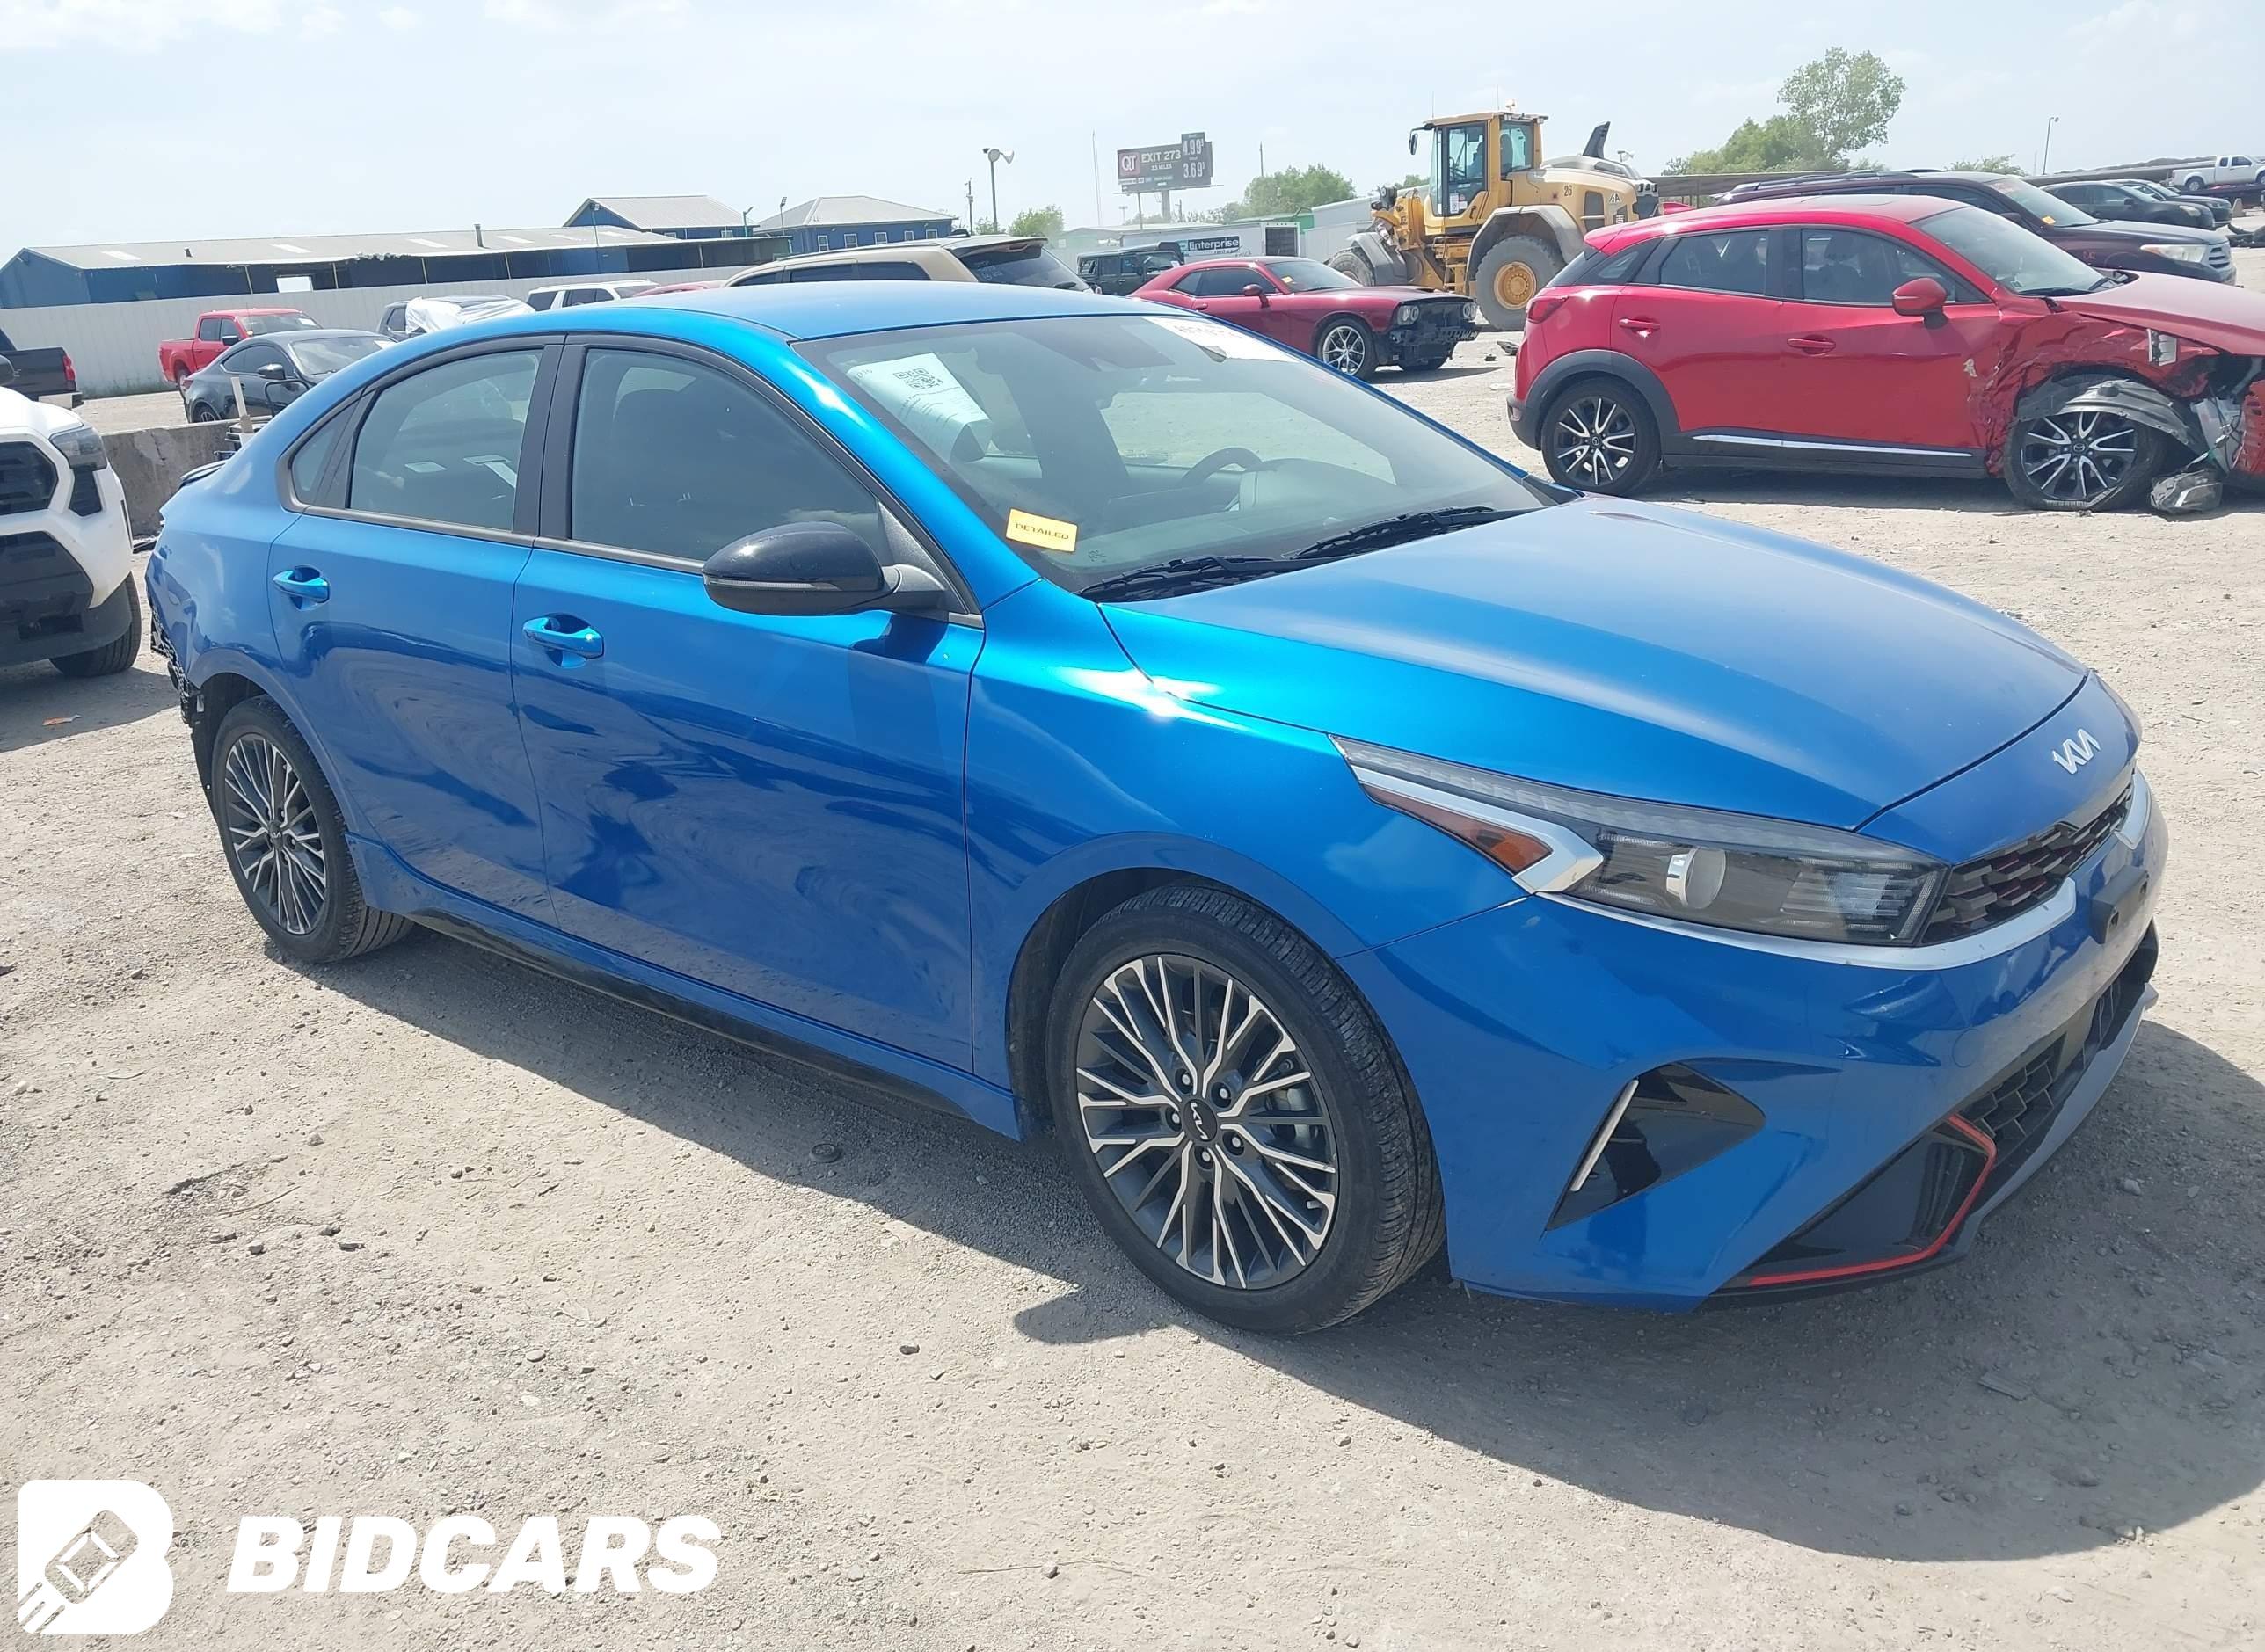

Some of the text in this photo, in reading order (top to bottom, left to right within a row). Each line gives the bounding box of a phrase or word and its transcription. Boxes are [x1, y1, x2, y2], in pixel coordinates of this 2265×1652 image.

[1140, 149, 1182, 163] EXIT 273
[1121, 155, 1137, 172] QT
[1563, 185, 1573, 197] 26
[1189, 237, 1239, 250] Enterprise
[1015, 522, 1069, 540] DETAILED
